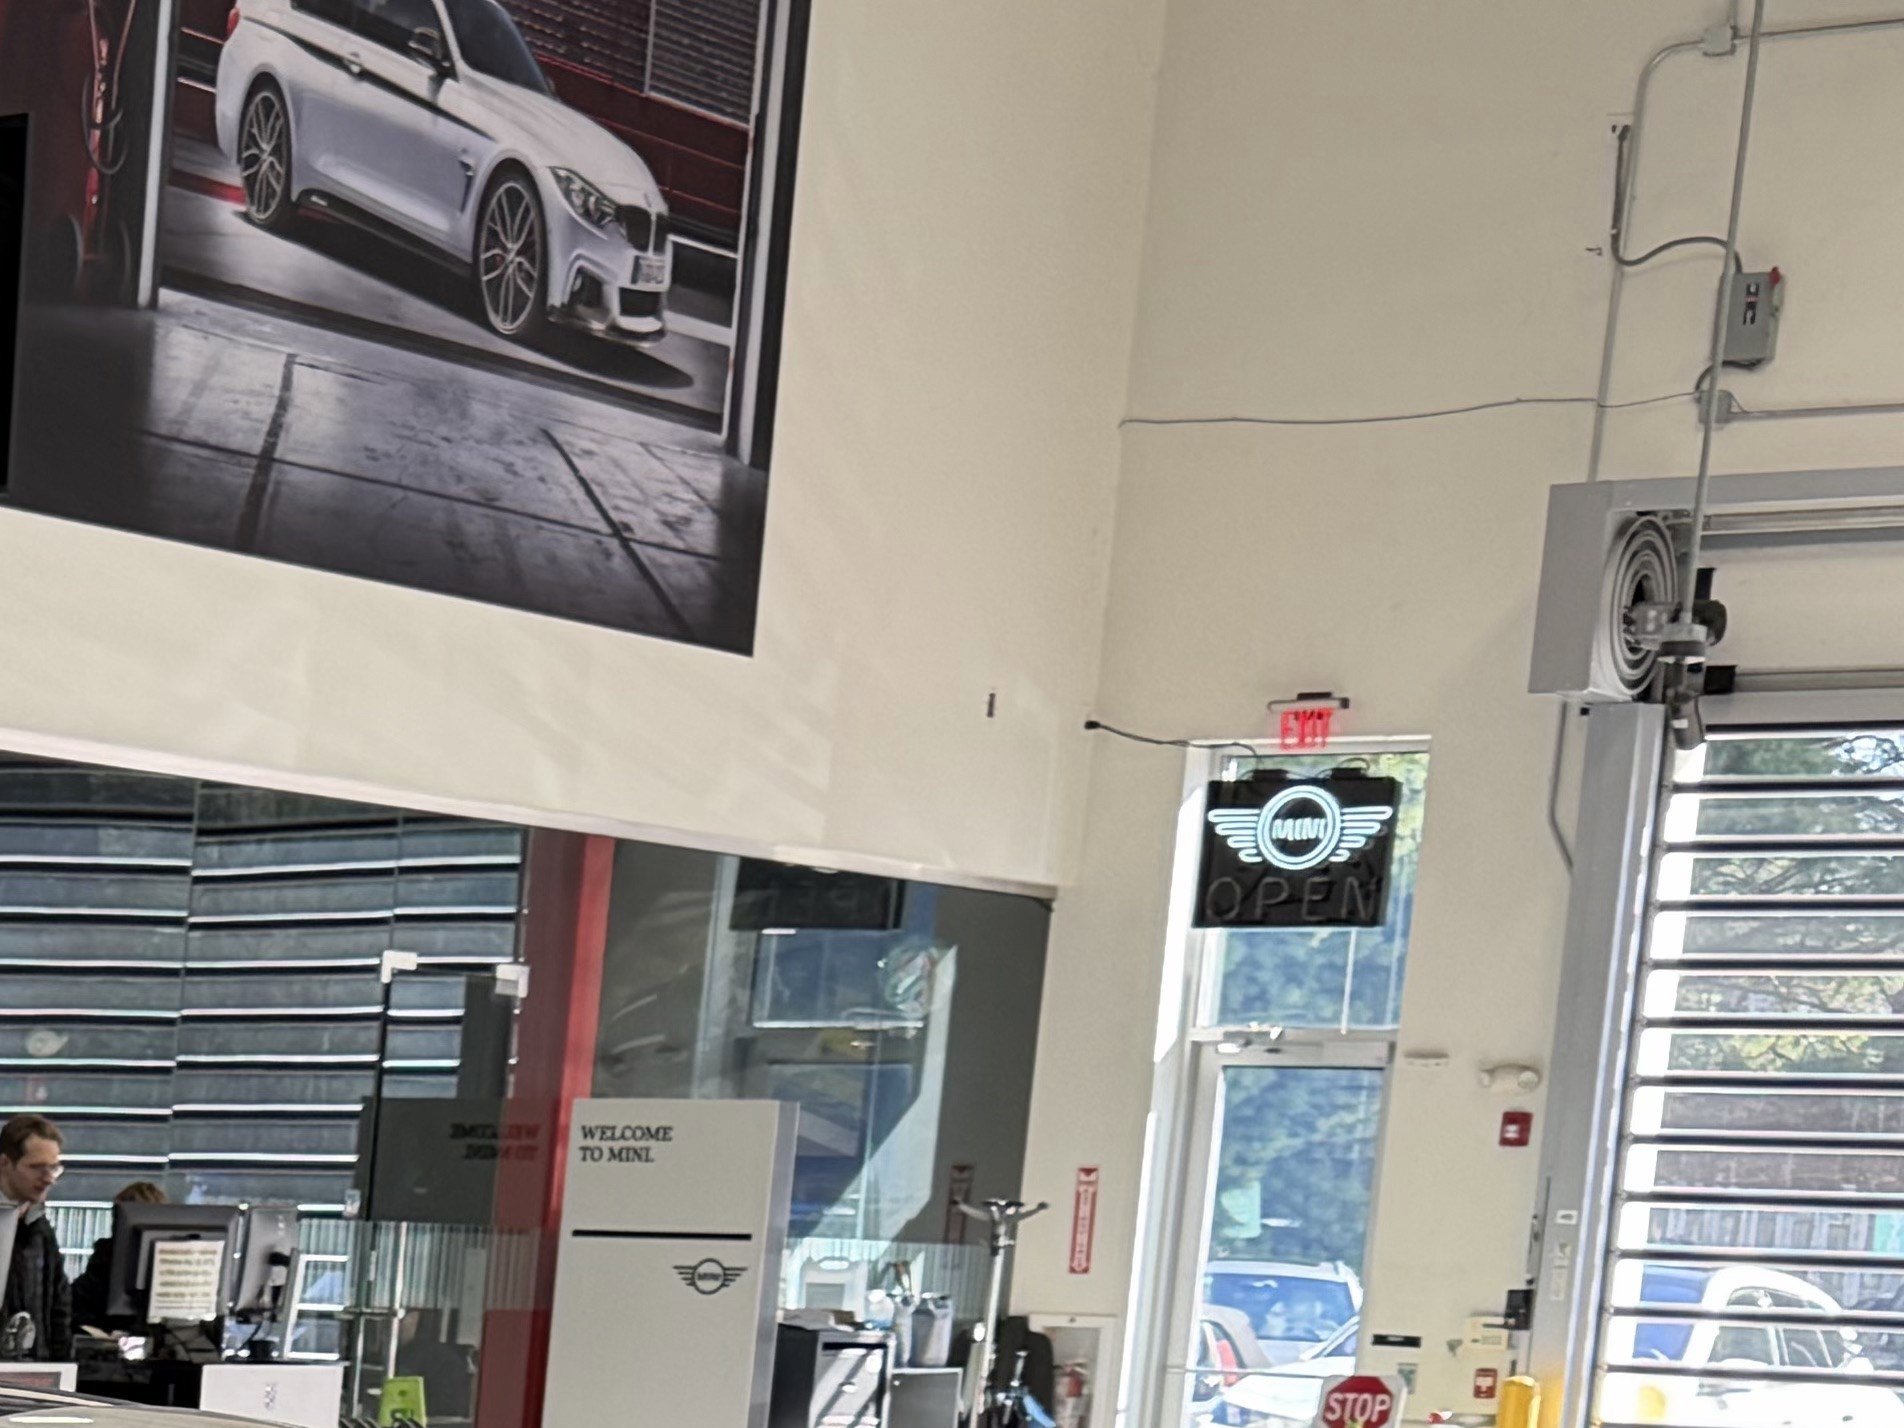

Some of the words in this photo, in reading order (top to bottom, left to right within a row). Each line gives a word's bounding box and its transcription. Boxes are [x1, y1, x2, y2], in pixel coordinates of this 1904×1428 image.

[1271, 817, 1326, 841] MINI
[1206, 876, 1376, 920] OPEN
[580, 1125, 674, 1142] WELCOME
[579, 1146, 603, 1161] TO
[1324, 1391, 1391, 1424] STOP
